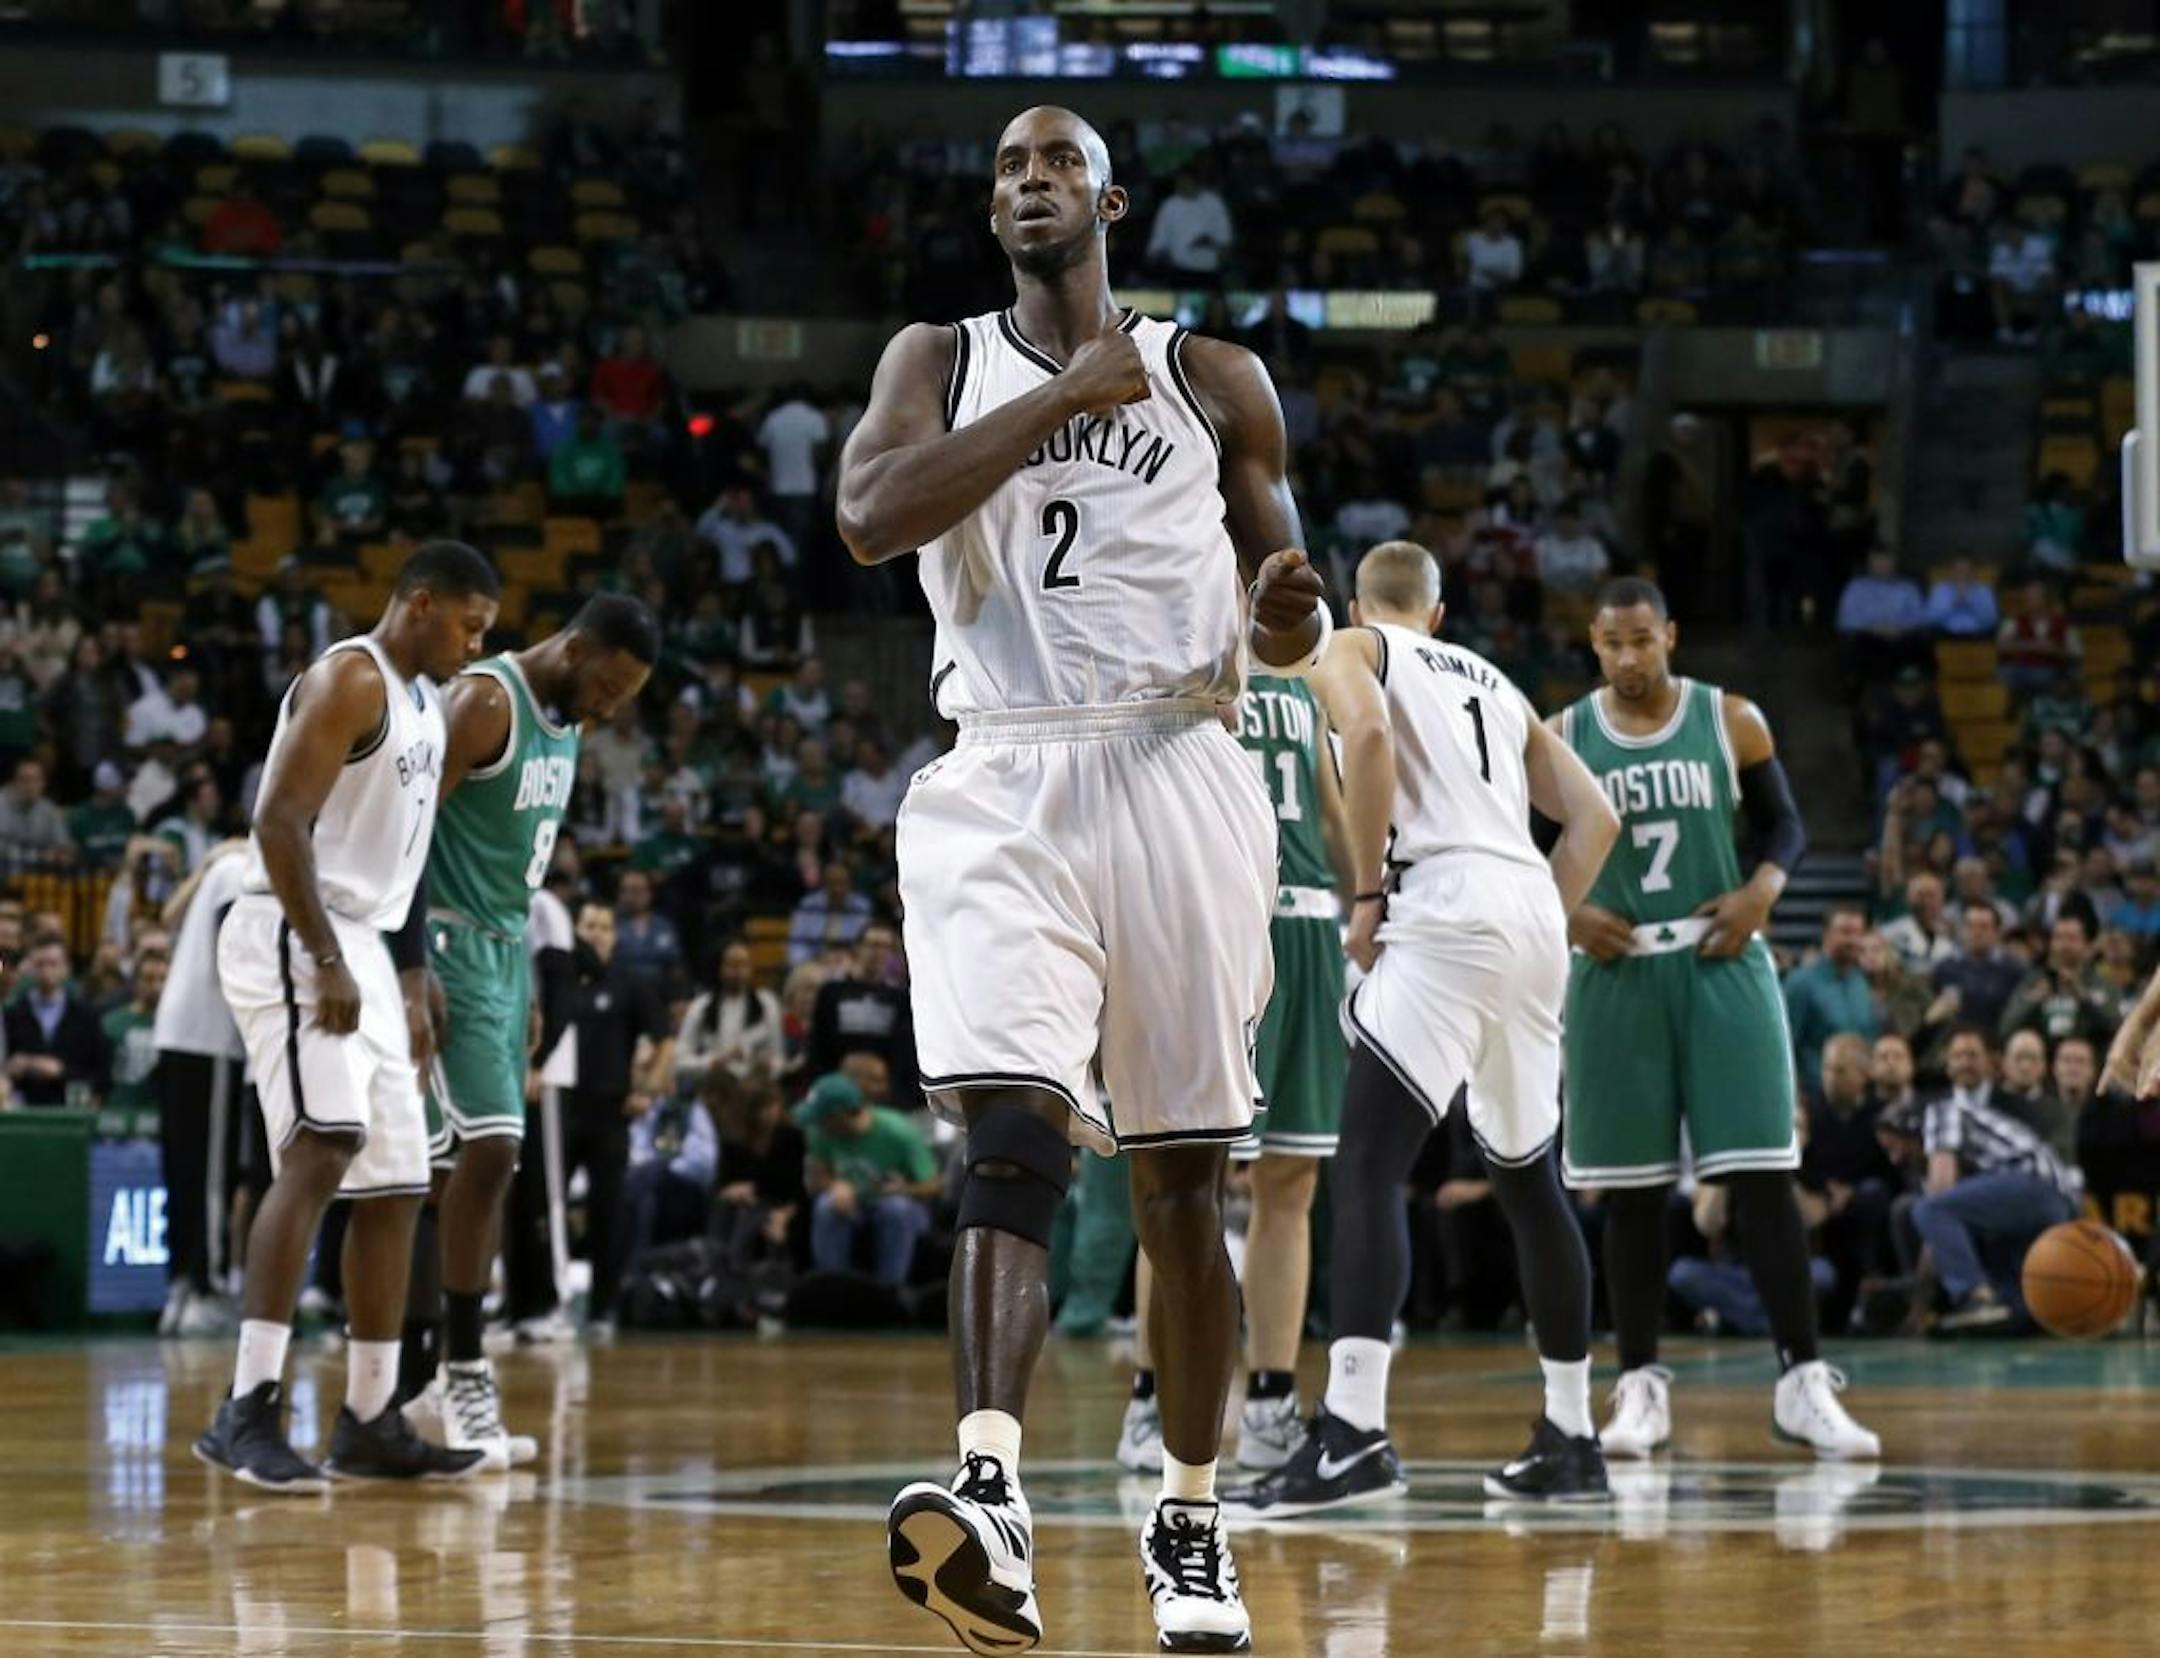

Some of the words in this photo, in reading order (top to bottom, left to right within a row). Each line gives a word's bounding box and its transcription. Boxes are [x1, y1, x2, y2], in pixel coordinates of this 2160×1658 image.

[1020, 414, 1175, 484] OKLYN
[1041, 499, 1080, 589] 2
[1461, 695, 1492, 785] 1
[1595, 759, 1713, 817] OSTON
[524, 818, 559, 888] 8
[1631, 819, 1680, 894] 7
